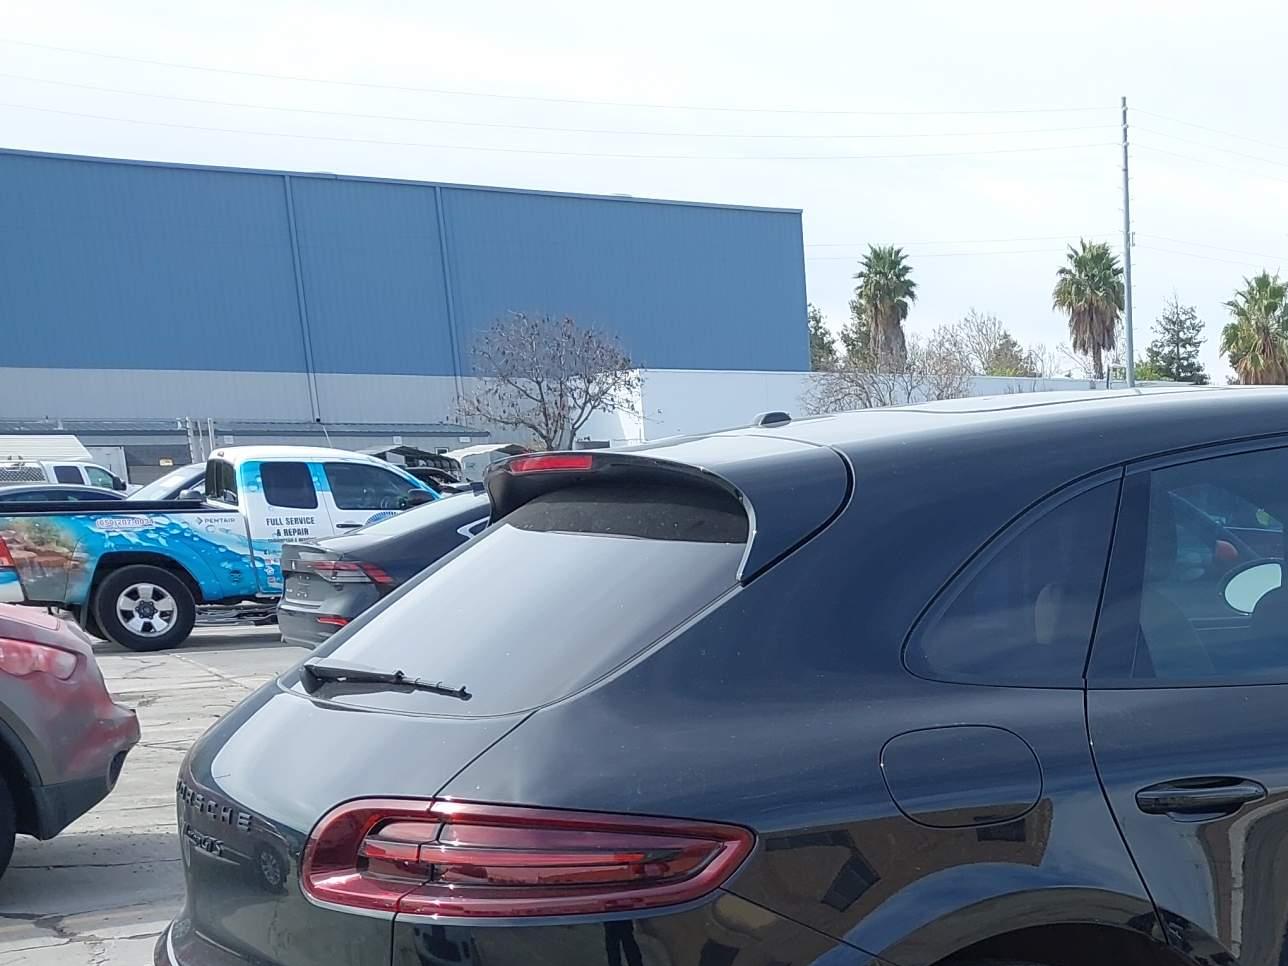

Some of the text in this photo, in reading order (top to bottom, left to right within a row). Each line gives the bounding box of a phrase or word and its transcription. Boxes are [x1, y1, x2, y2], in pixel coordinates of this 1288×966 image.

[266, 516, 315, 526] FULL SERVICE
[283, 527, 309, 537] REPAIR
